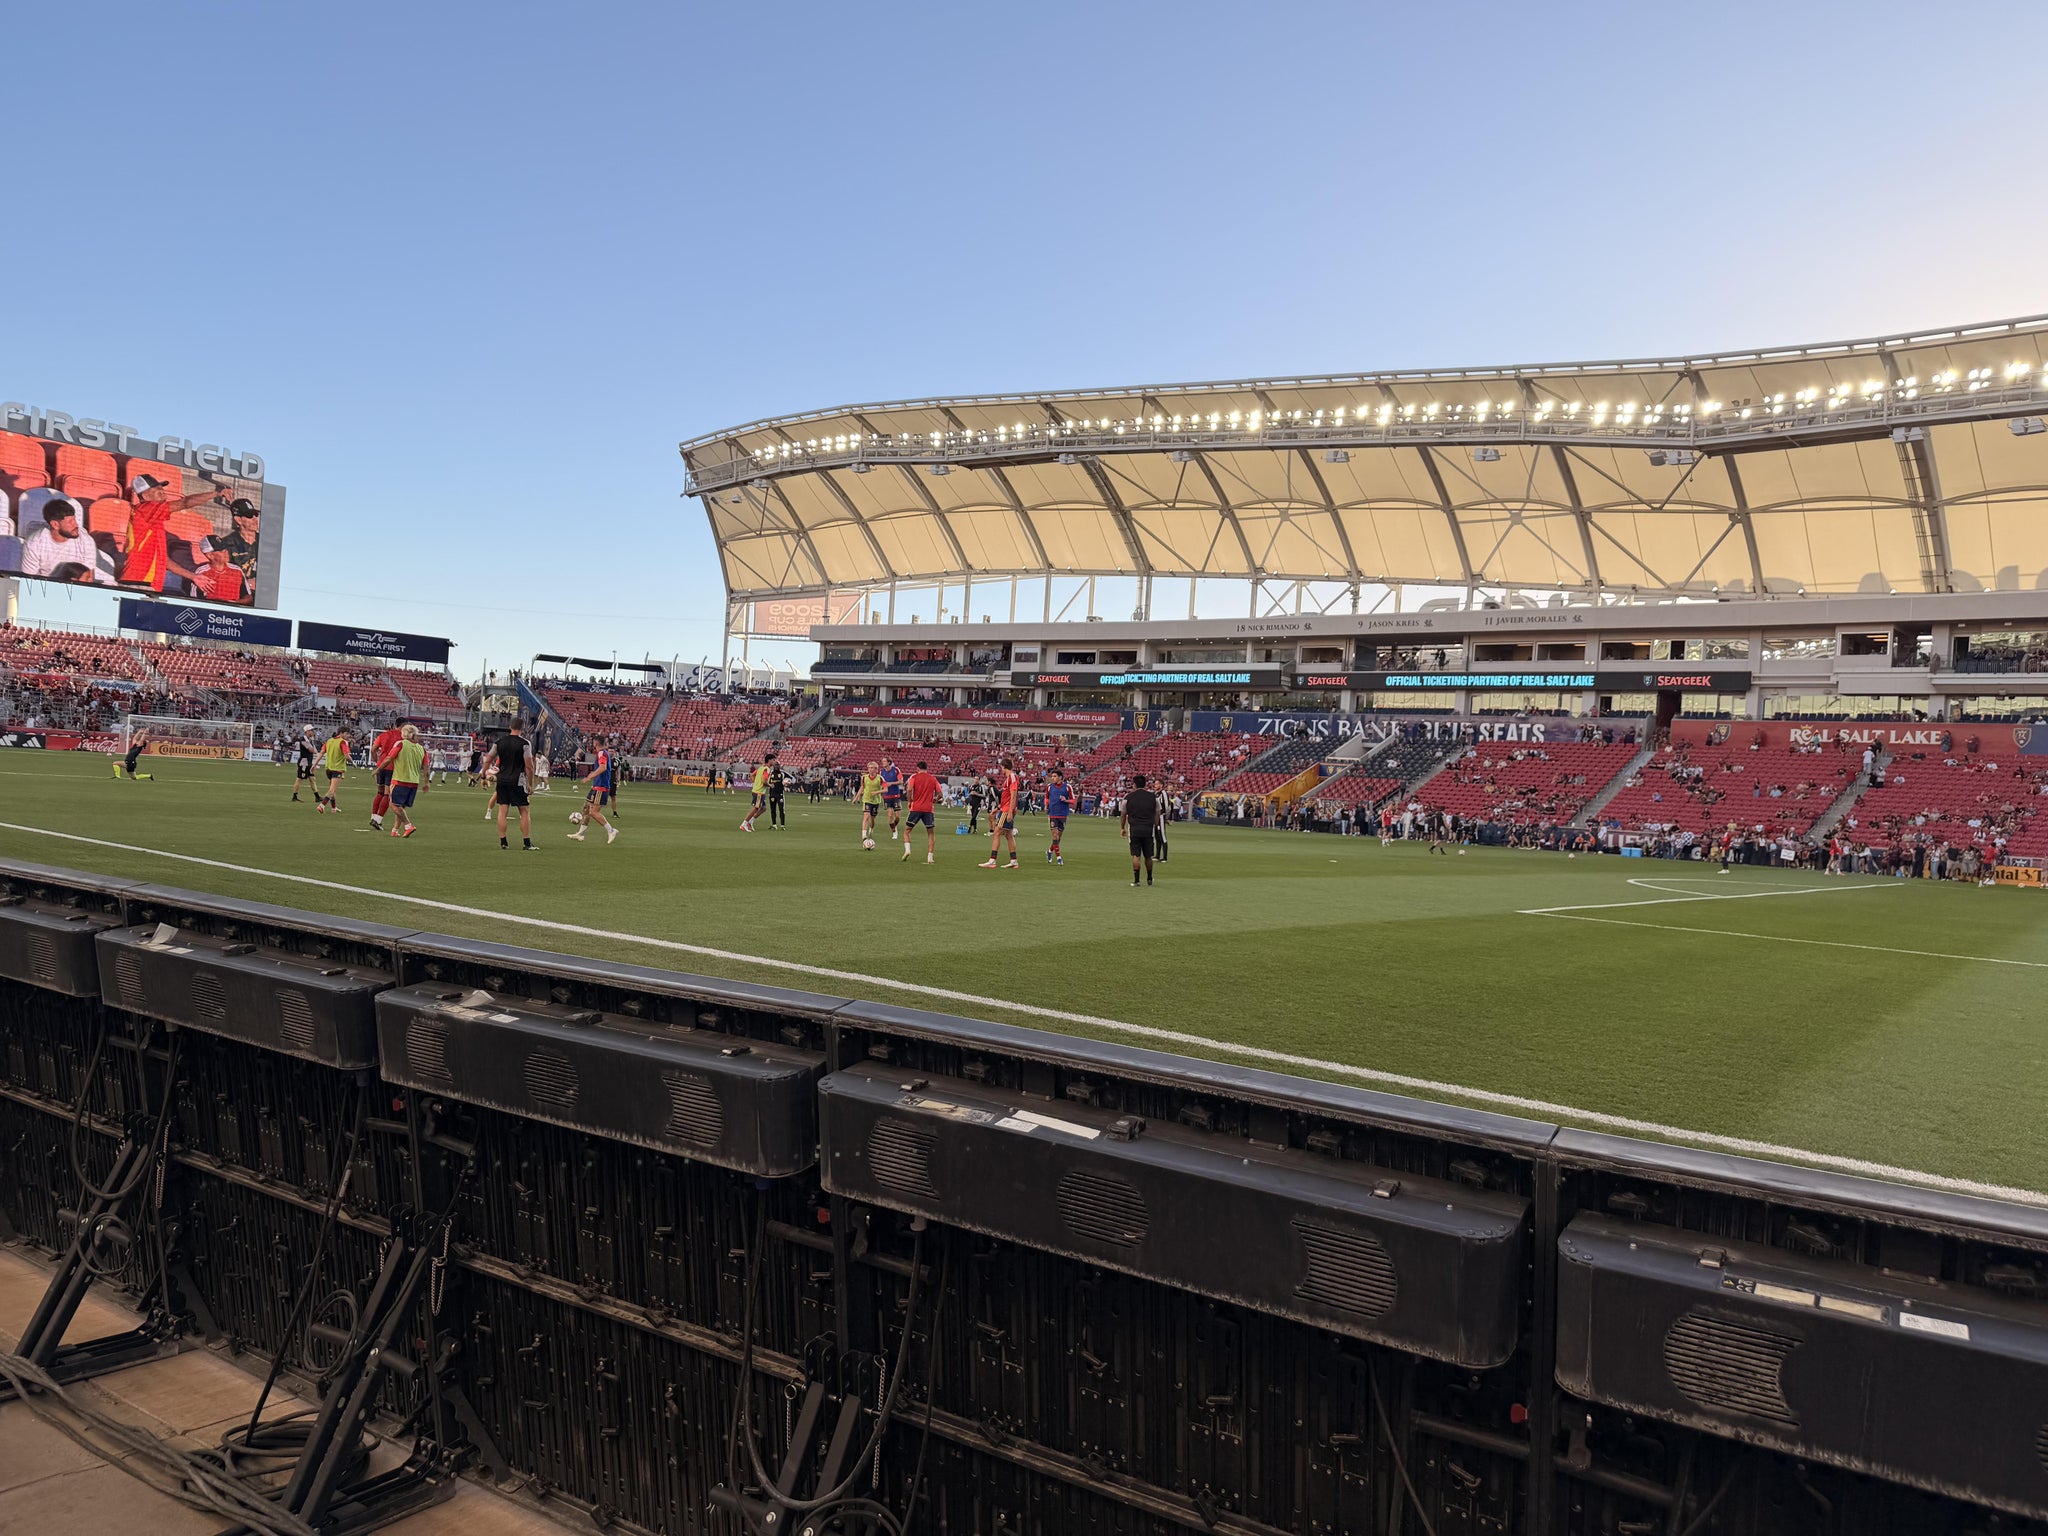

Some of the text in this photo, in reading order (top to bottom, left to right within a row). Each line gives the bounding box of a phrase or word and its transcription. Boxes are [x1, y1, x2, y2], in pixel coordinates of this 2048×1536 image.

[1, 402, 266, 480] FIRST FIELD
[207, 613, 244, 627] Select
[1357, 621, 1364, 629] 9
[1368, 621, 1394, 629] JASON
[1496, 617, 1524, 626] JAVIER
[1526, 615, 1567, 624] MORALES
[206, 624, 241, 637] Health
[345, 639, 382, 650] AMERICA
[382, 643, 407, 653] FIRST
[1037, 674, 1070, 684] SEATGEEK
[1099, 675, 1125, 685] OFFICIA
[1157, 673, 1188, 683] PARTNER
[1188, 674, 1198, 683] OF
[1198, 674, 1214, 683] REAL
[1215, 674, 1232, 683] SALT
[1232, 674, 1251, 683] LAKE
[1307, 676, 1348, 686] SEATGEEK
[1385, 675, 1595, 686] OFFICIAL TICKETING PARTNER OF REAL SALT LAKE
[1657, 675, 1712, 687] SEATGEEK
[589, 685, 611, 694] Ford
[631, 688, 653, 698] Ford
[1478, 722, 1545, 743] SEATS
[1839, 728, 1885, 744] SALT
[1889, 729, 1943, 745] LAKE
[158, 744, 211, 756] Continental
